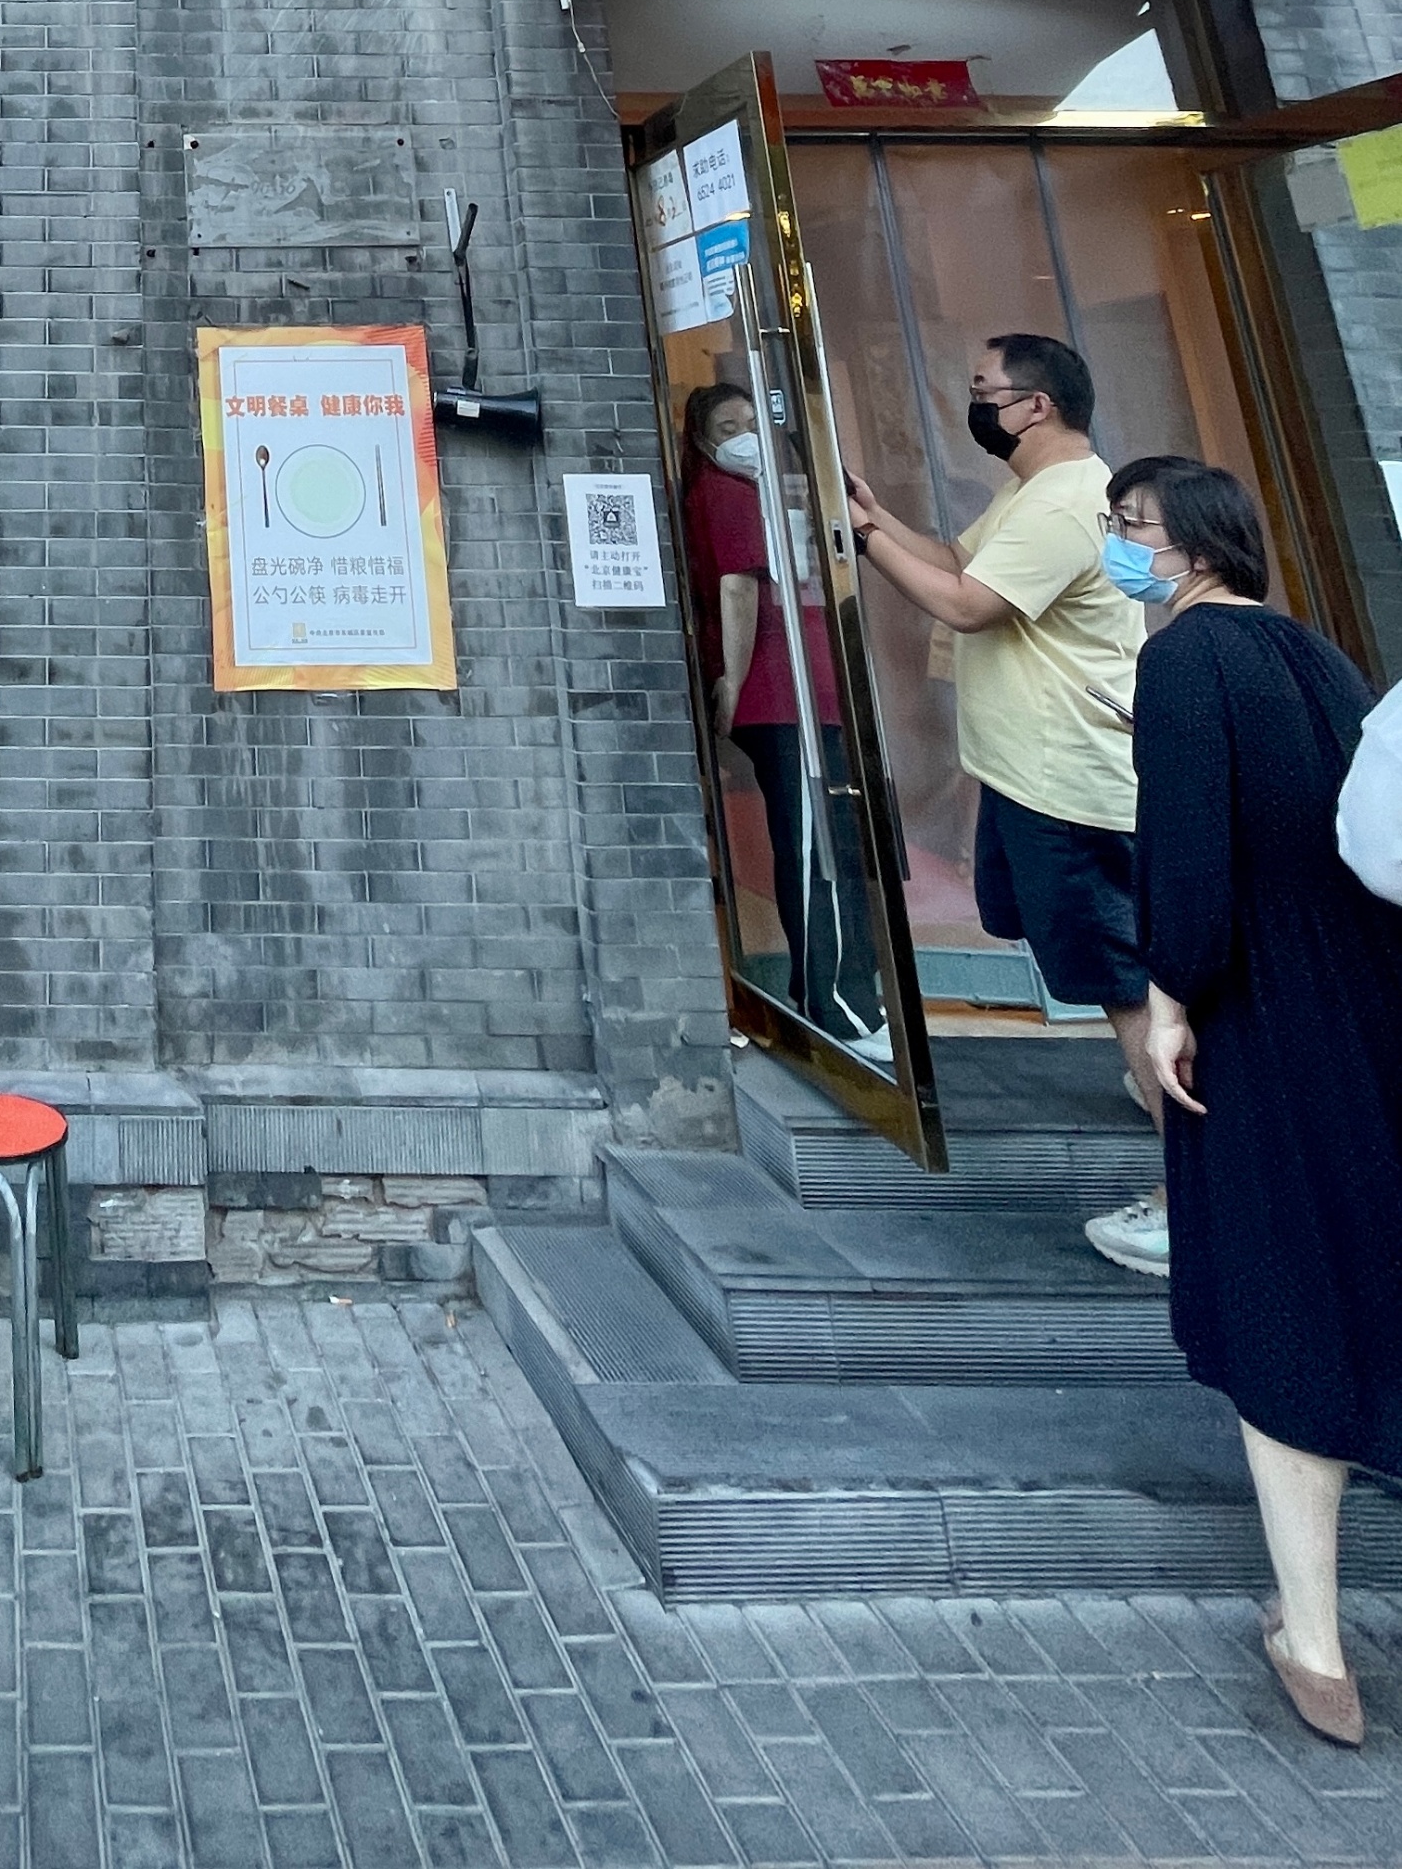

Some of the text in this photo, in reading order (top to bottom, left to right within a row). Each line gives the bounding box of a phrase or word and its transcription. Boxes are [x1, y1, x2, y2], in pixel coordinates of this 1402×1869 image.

[225, 394, 405, 417] 文明餐桌 健康你我
[251, 556, 404, 577] 盘光碗净 惜粮惜福
[590, 550, 641, 562] 请主动打开
[253, 585, 406, 606] 公勺公筷 病毒走开
[592, 579, 645, 591] 扫描二维码
